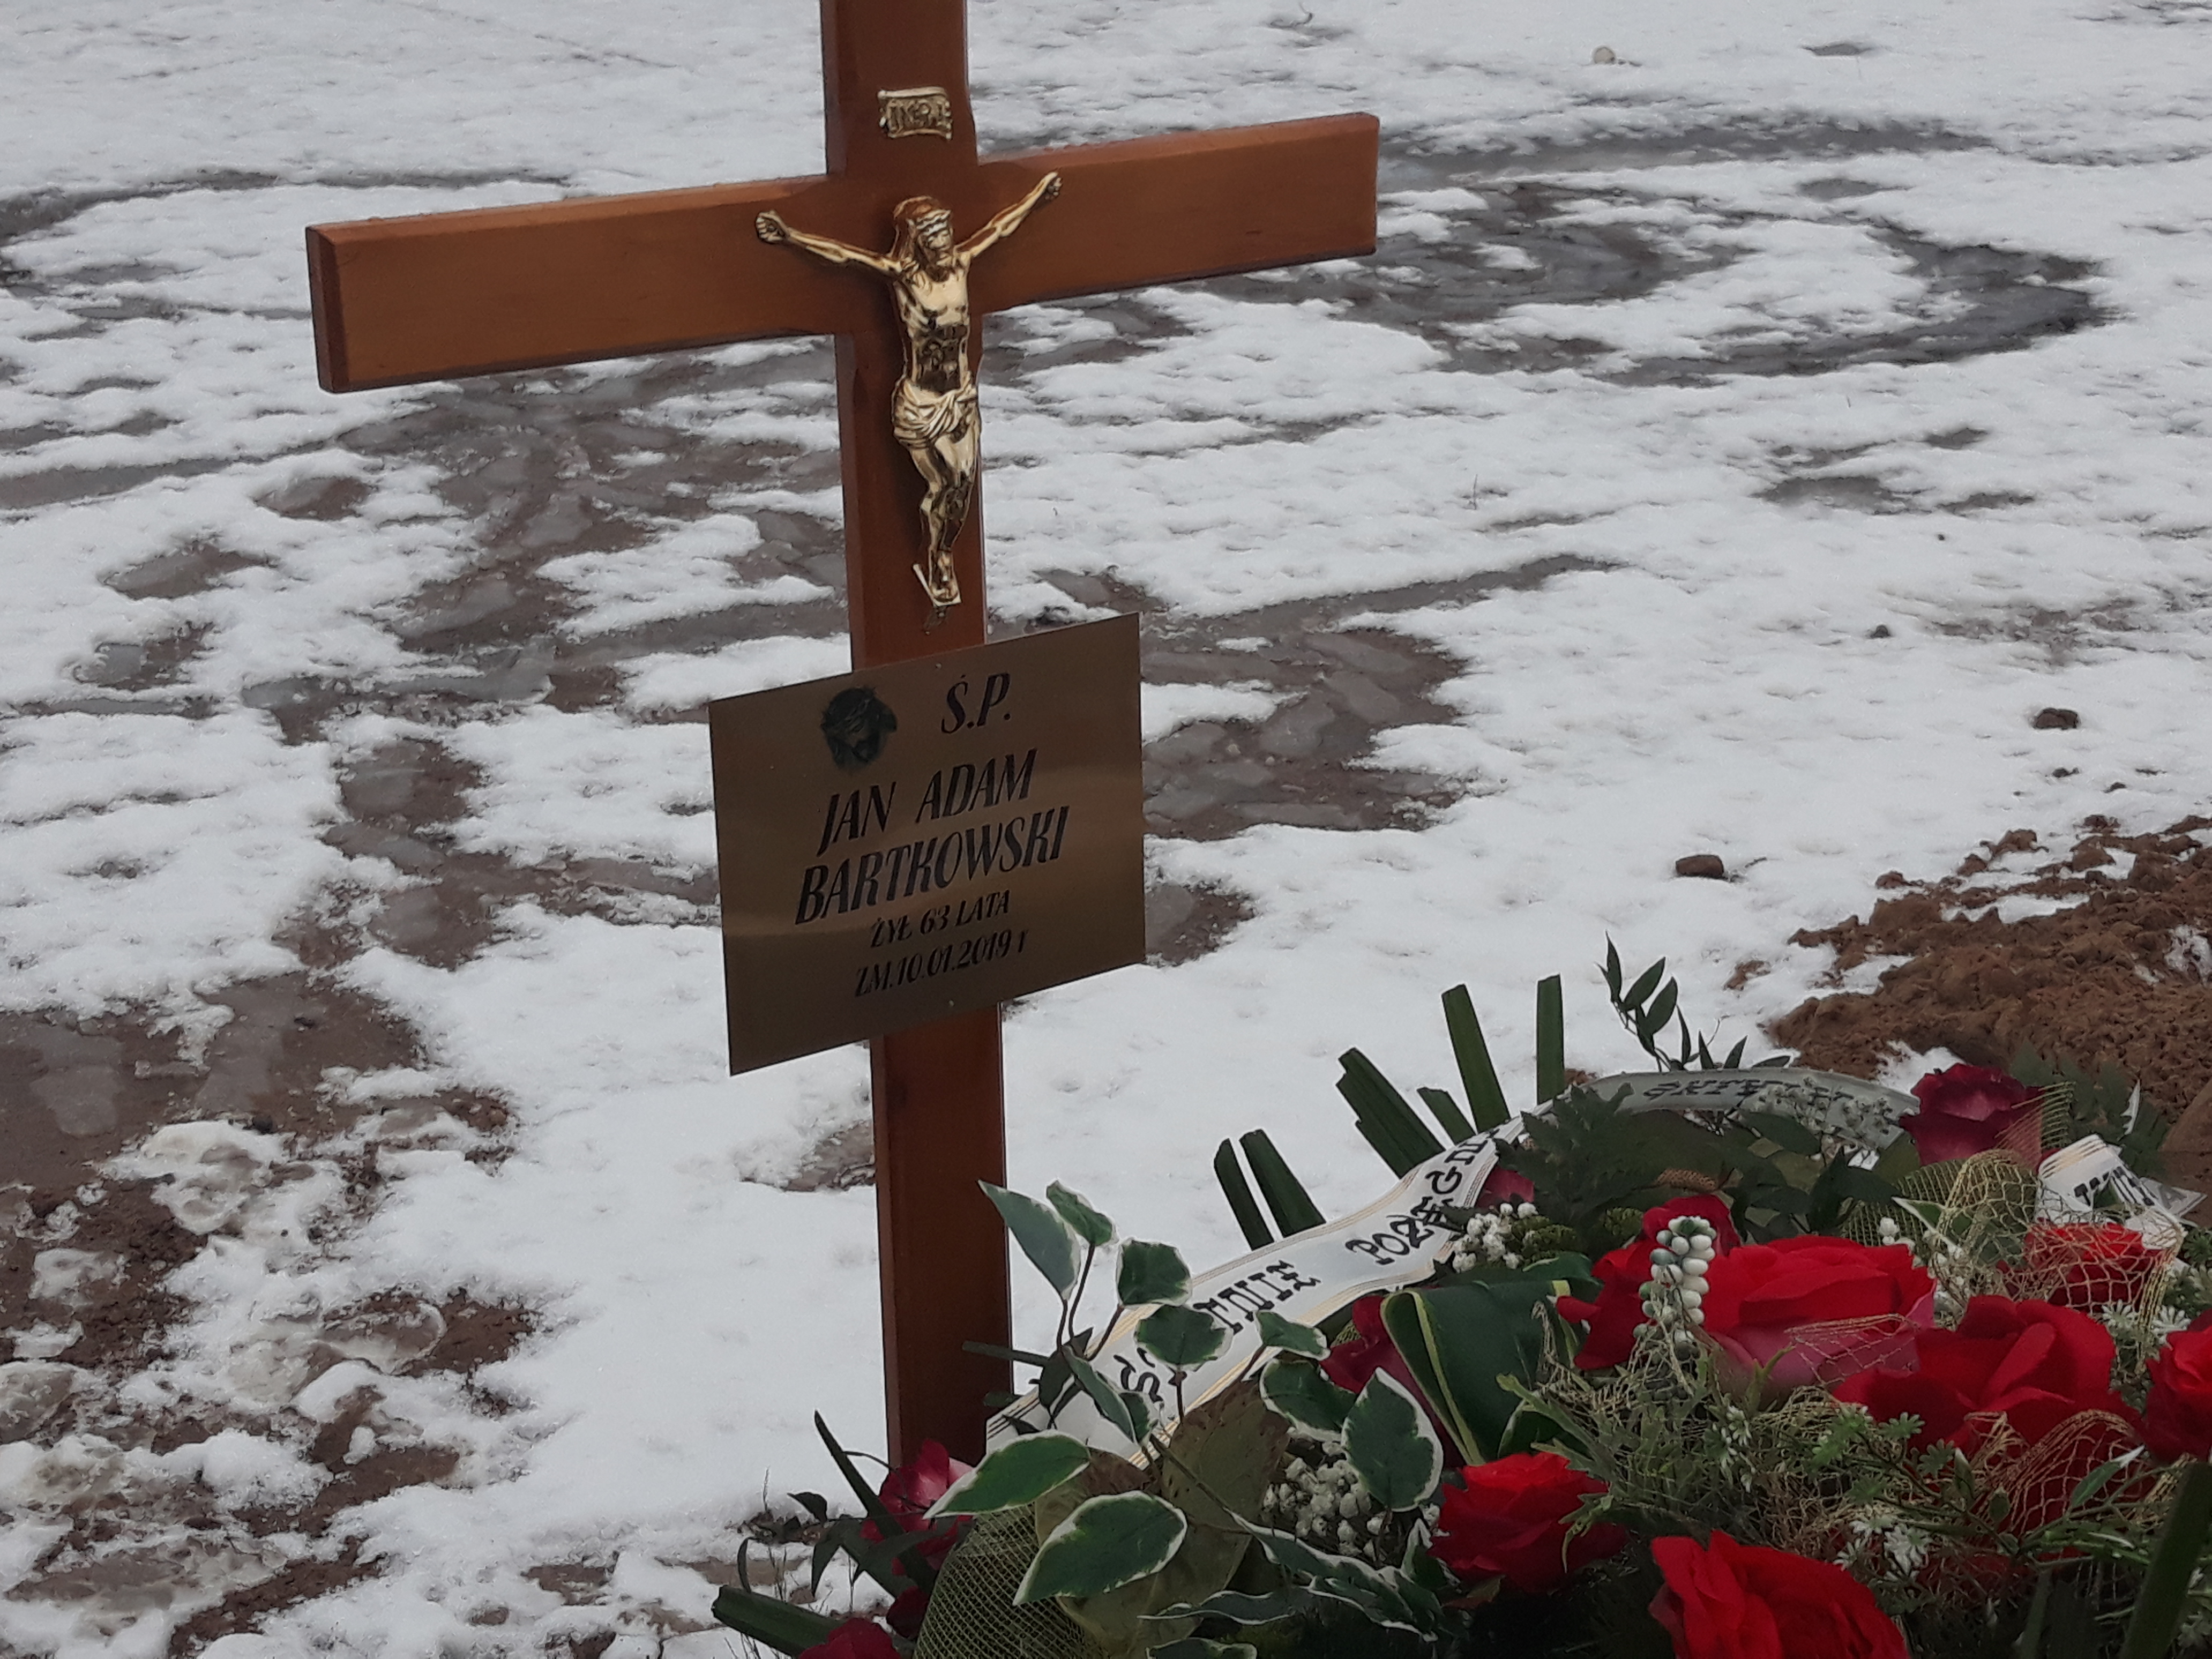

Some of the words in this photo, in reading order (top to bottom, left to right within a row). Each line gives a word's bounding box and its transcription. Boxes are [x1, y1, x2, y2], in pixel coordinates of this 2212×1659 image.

[816, 781, 896, 857] JAN
[915, 748, 1038, 824] ADAM
[795, 805, 1071, 926] BARTKOWSKI
[920, 905, 951, 935] 63
[955, 889, 1010, 927] LATA
